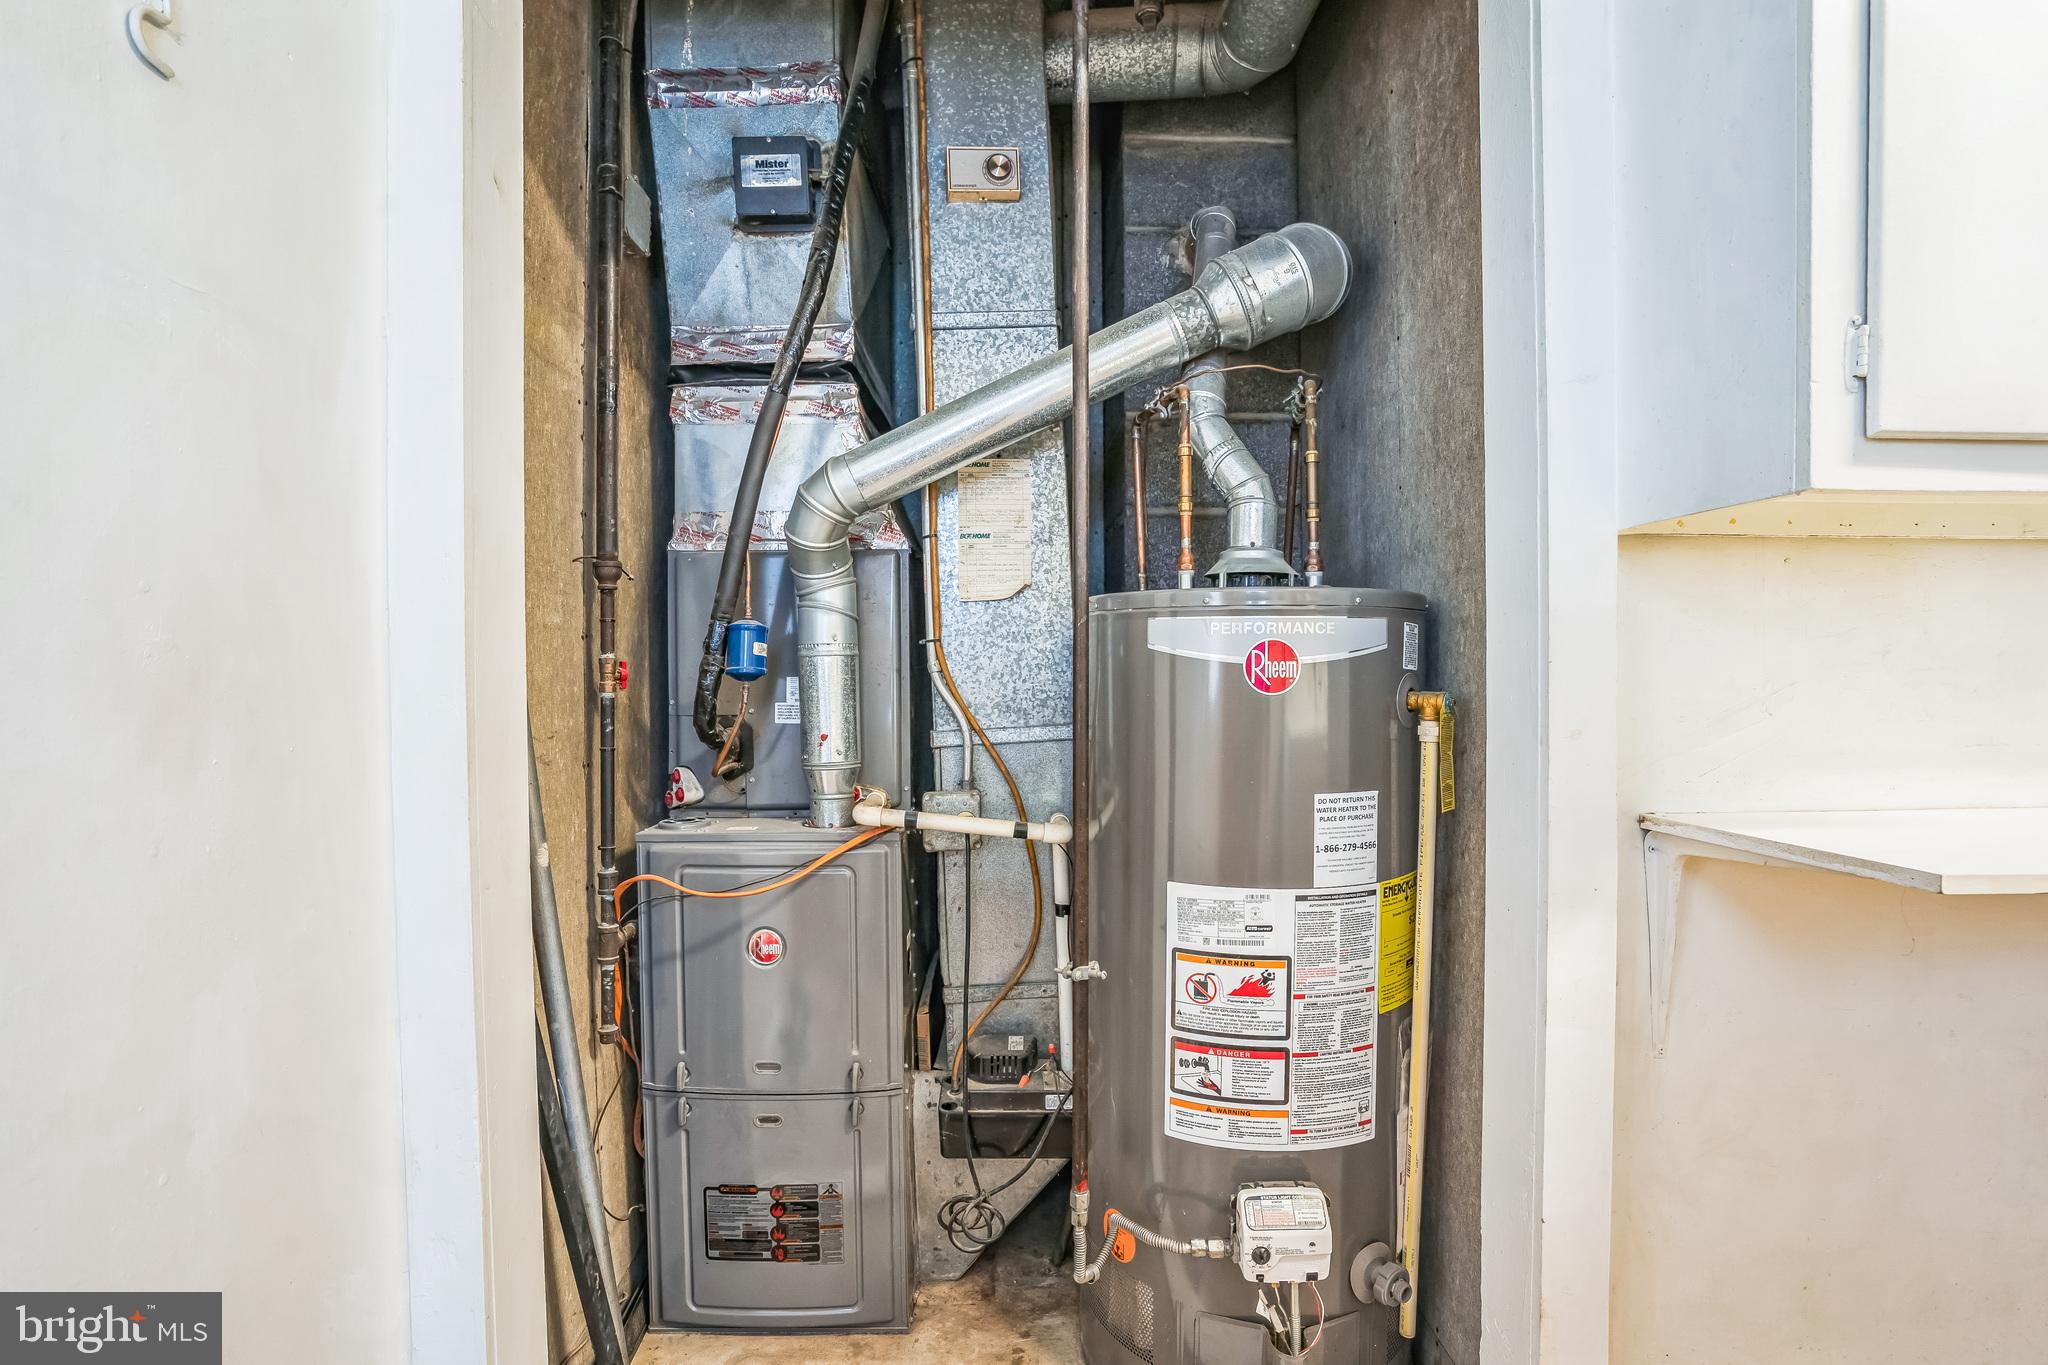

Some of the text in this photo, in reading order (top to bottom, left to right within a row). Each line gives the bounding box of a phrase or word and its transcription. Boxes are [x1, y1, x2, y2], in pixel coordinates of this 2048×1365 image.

[755, 159, 789, 169] Mister
[1210, 621, 1336, 635] PERFORMANCE
[1250, 640, 1298, 686] Rheem
[1342, 796, 1364, 804] RETURN
[1316, 806, 1337, 814] WATER
[1338, 805, 1359, 813] HEATER
[1347, 813, 1374, 821] PURCHASE
[1315, 840, 1377, 853] 1-866-279-4566
[1215, 959, 1256, 967] WARNING
[1216, 1049, 1251, 1058] DANGER
[1215, 1108, 1251, 1117] WARNING
